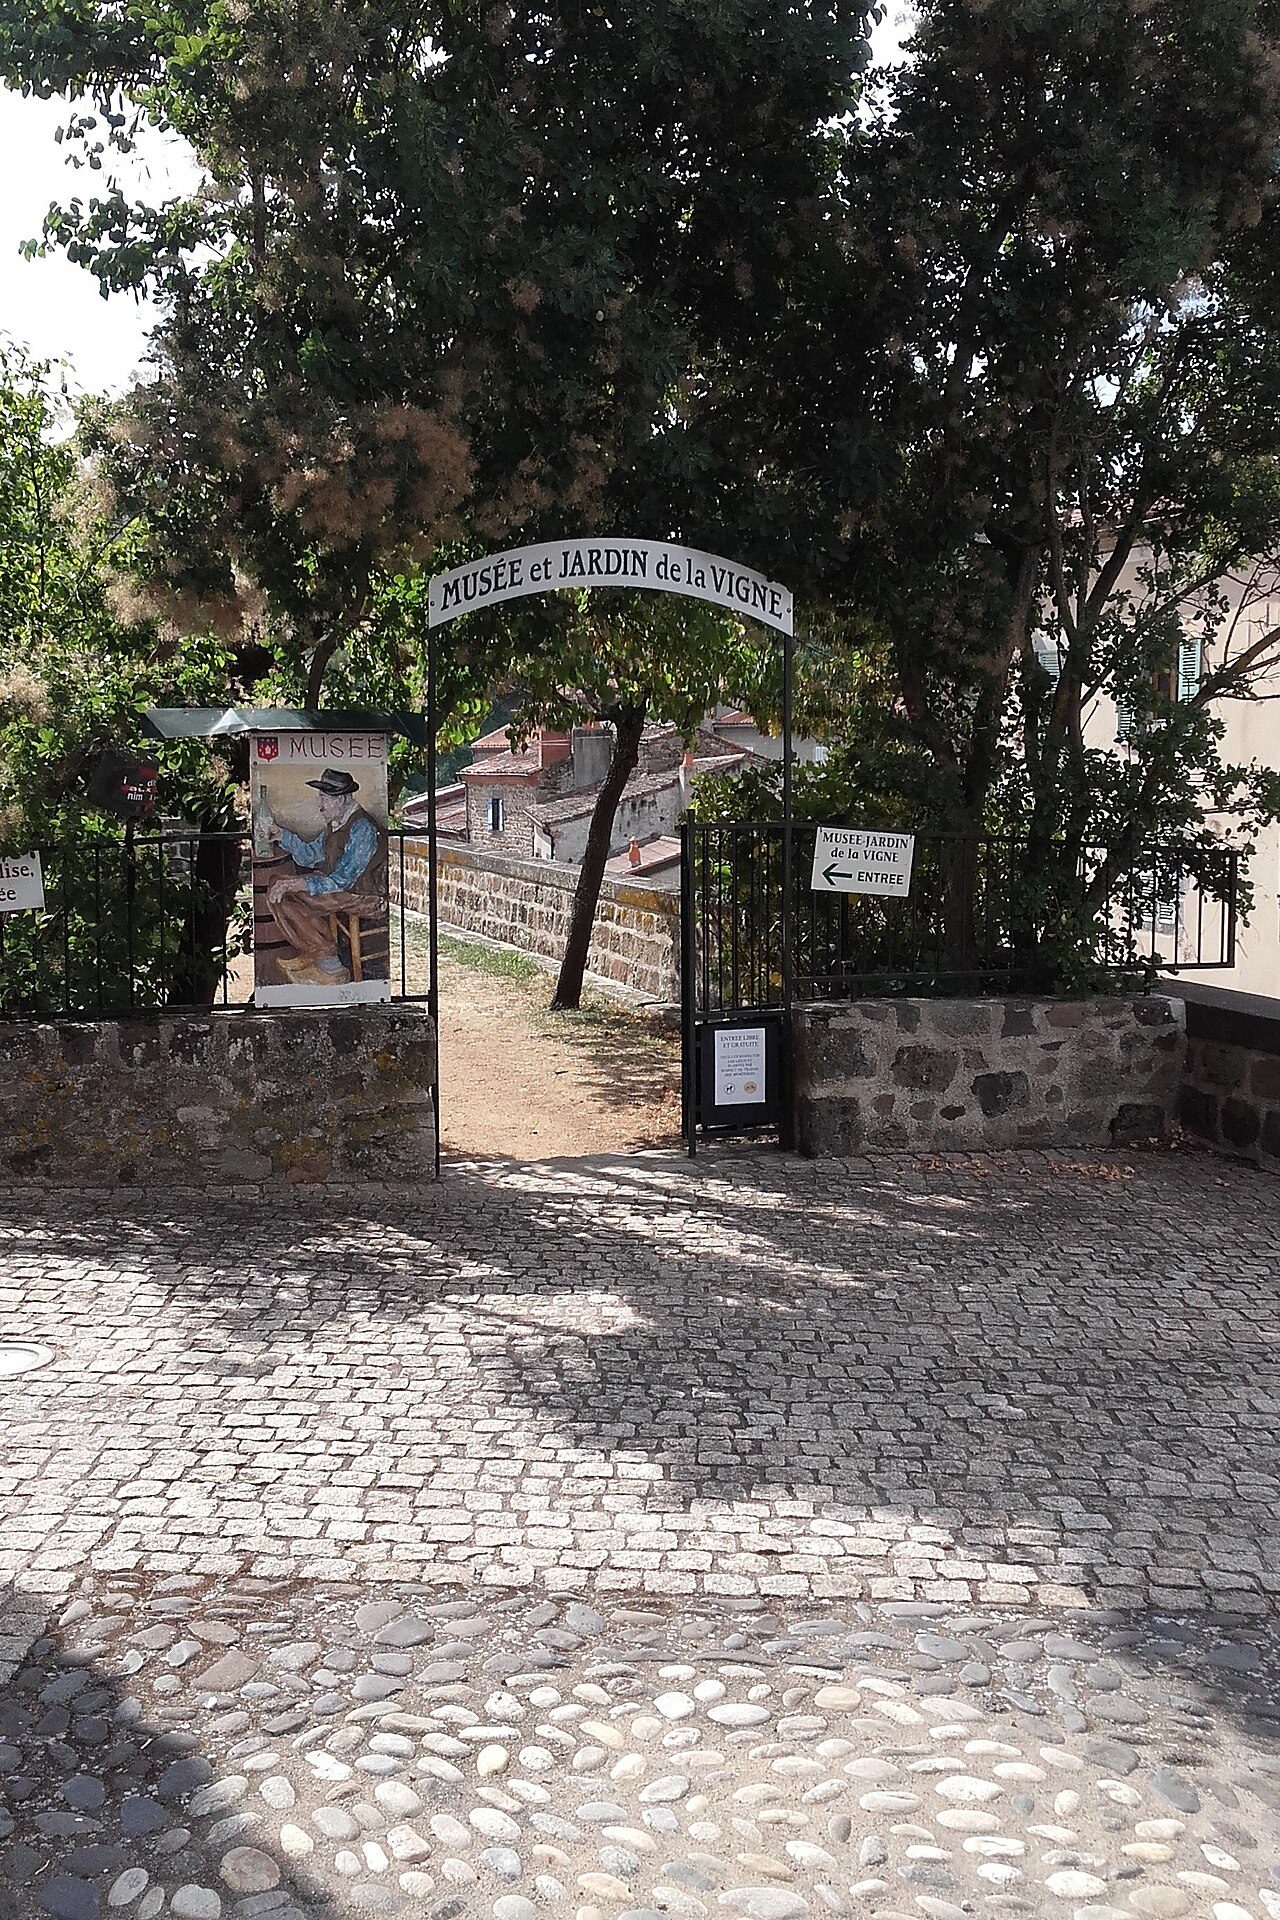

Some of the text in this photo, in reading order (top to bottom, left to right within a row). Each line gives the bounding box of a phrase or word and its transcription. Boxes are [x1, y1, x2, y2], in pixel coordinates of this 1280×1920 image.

[440, 548, 783, 620] MUSÉE et JARDIN de la VIGNE
[289, 736, 384, 758] MUSEE
[830, 847, 899, 863] de la VIGNE
[857, 871, 904, 885] ENTREE
